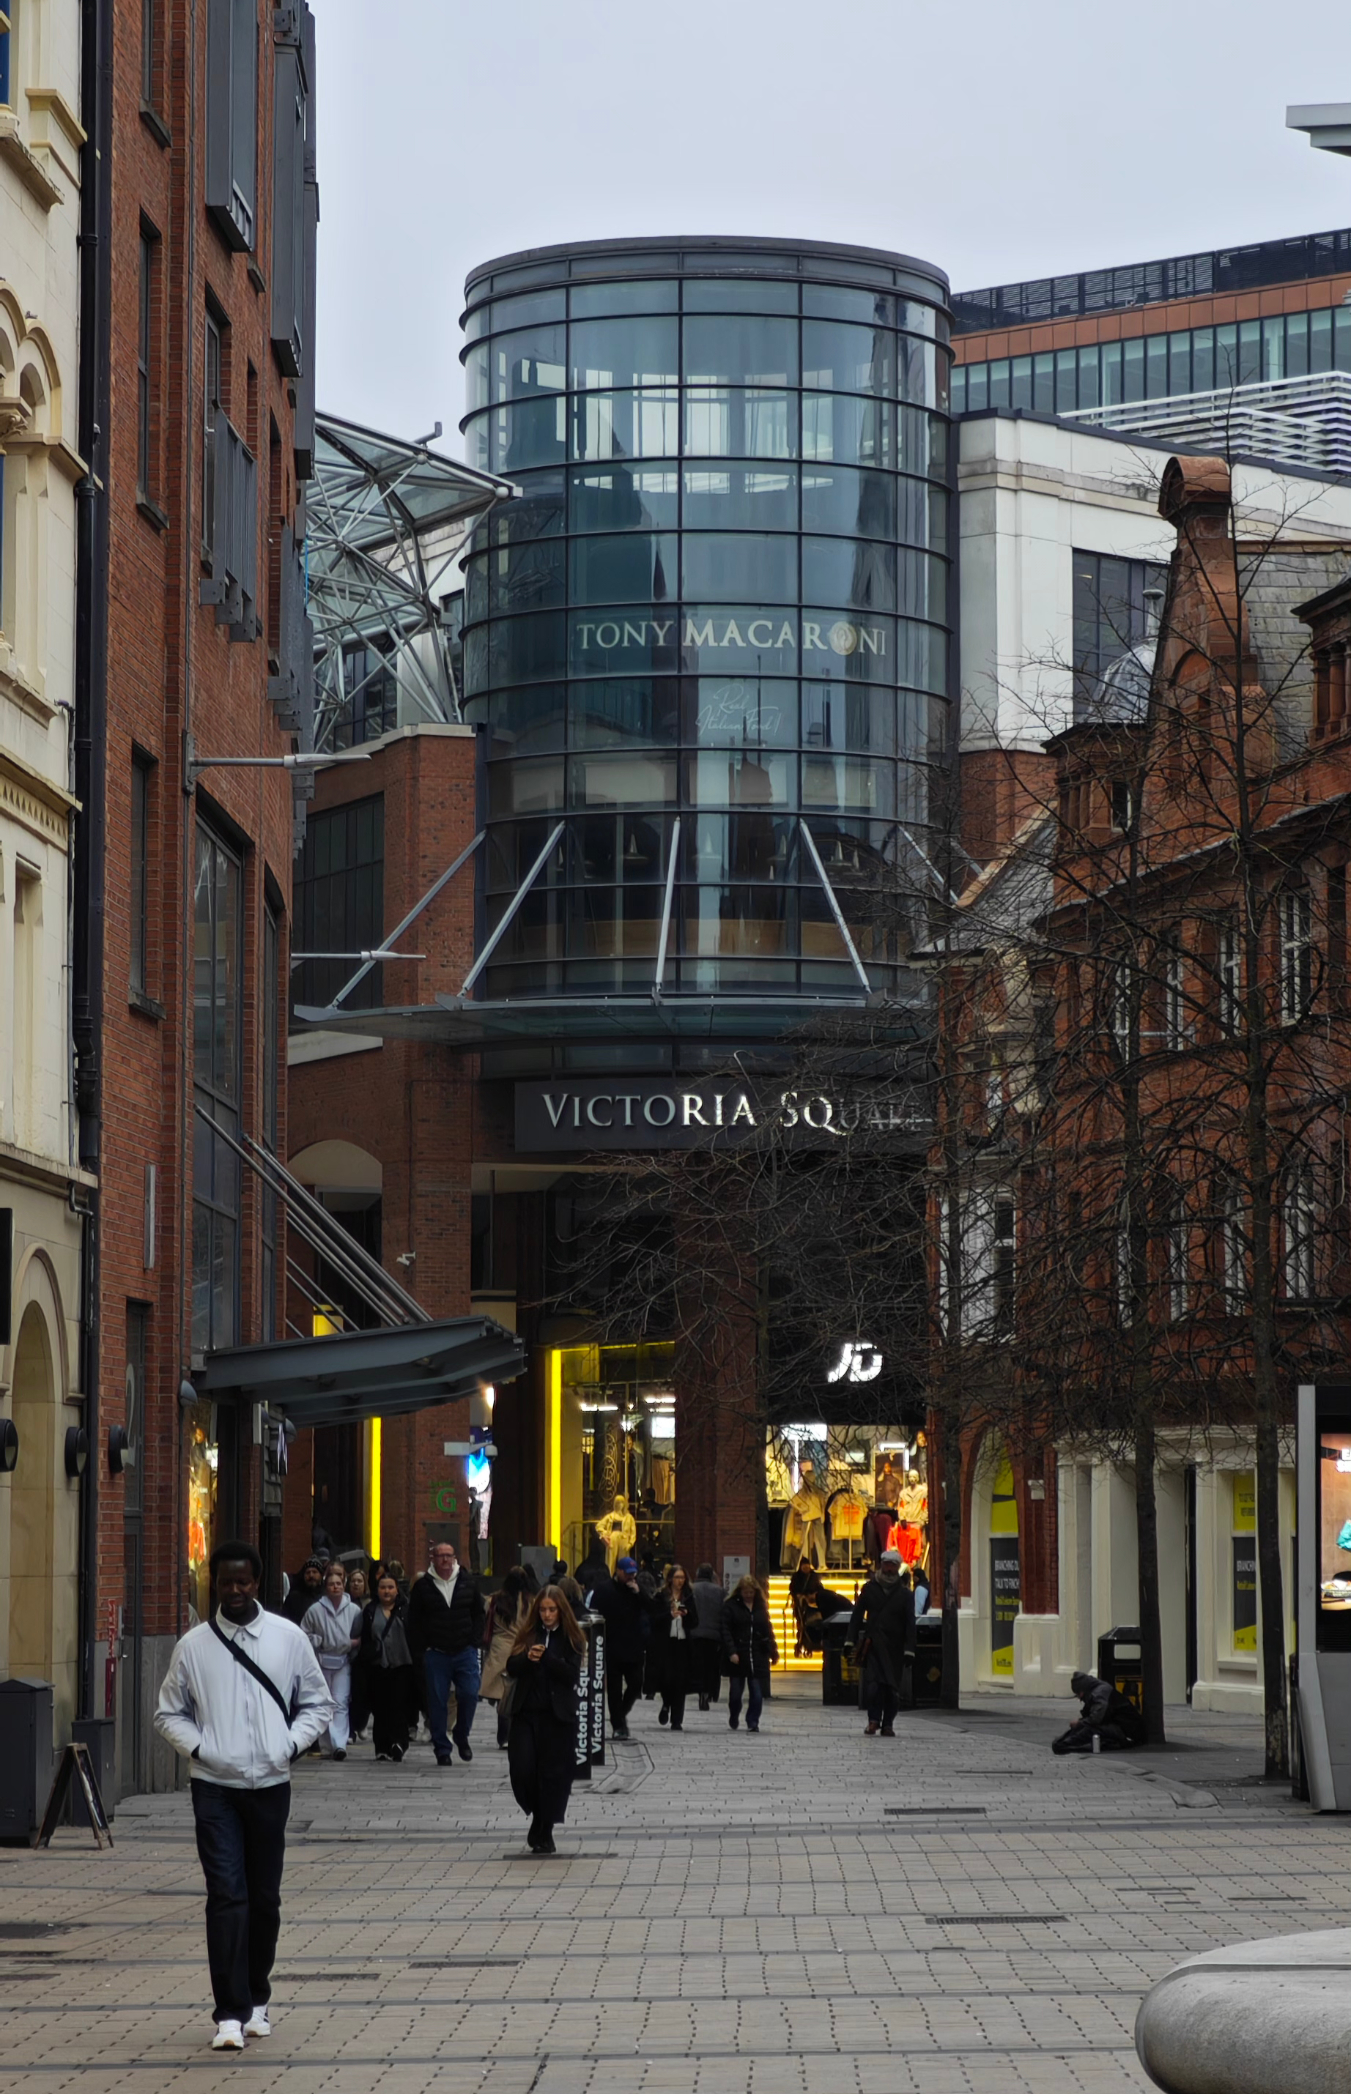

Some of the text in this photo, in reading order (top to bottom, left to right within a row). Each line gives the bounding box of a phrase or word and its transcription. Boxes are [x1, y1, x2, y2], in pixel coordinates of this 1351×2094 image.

[577, 619, 886, 655] TONY MACARONI
[542, 1092, 758, 1128] VICTORIA
[827, 1343, 883, 1383] JD
[591, 1635, 605, 1754] Victoria Square
[575, 1701, 588, 1766] Victoria
